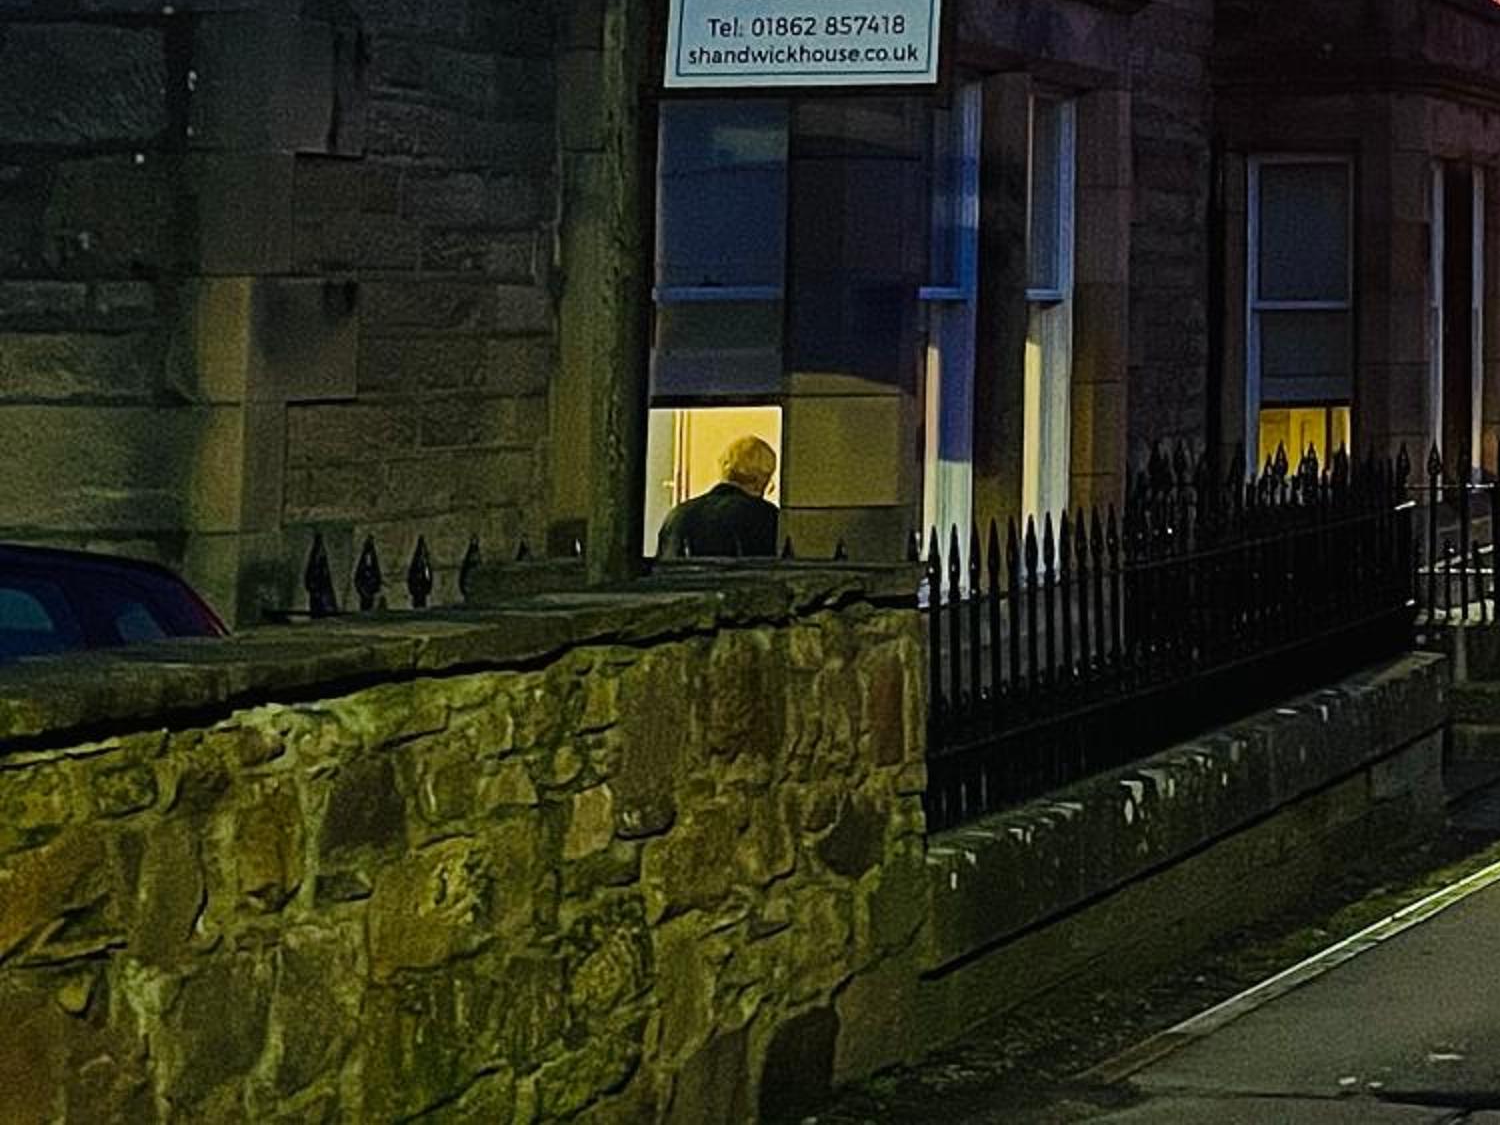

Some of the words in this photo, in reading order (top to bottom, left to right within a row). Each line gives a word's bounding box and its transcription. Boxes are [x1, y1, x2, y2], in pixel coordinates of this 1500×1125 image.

[751, 17, 817, 36] 01862
[825, 15, 905, 35] 857418
[688, 44, 918, 64] shandwickhouse.co.uk
